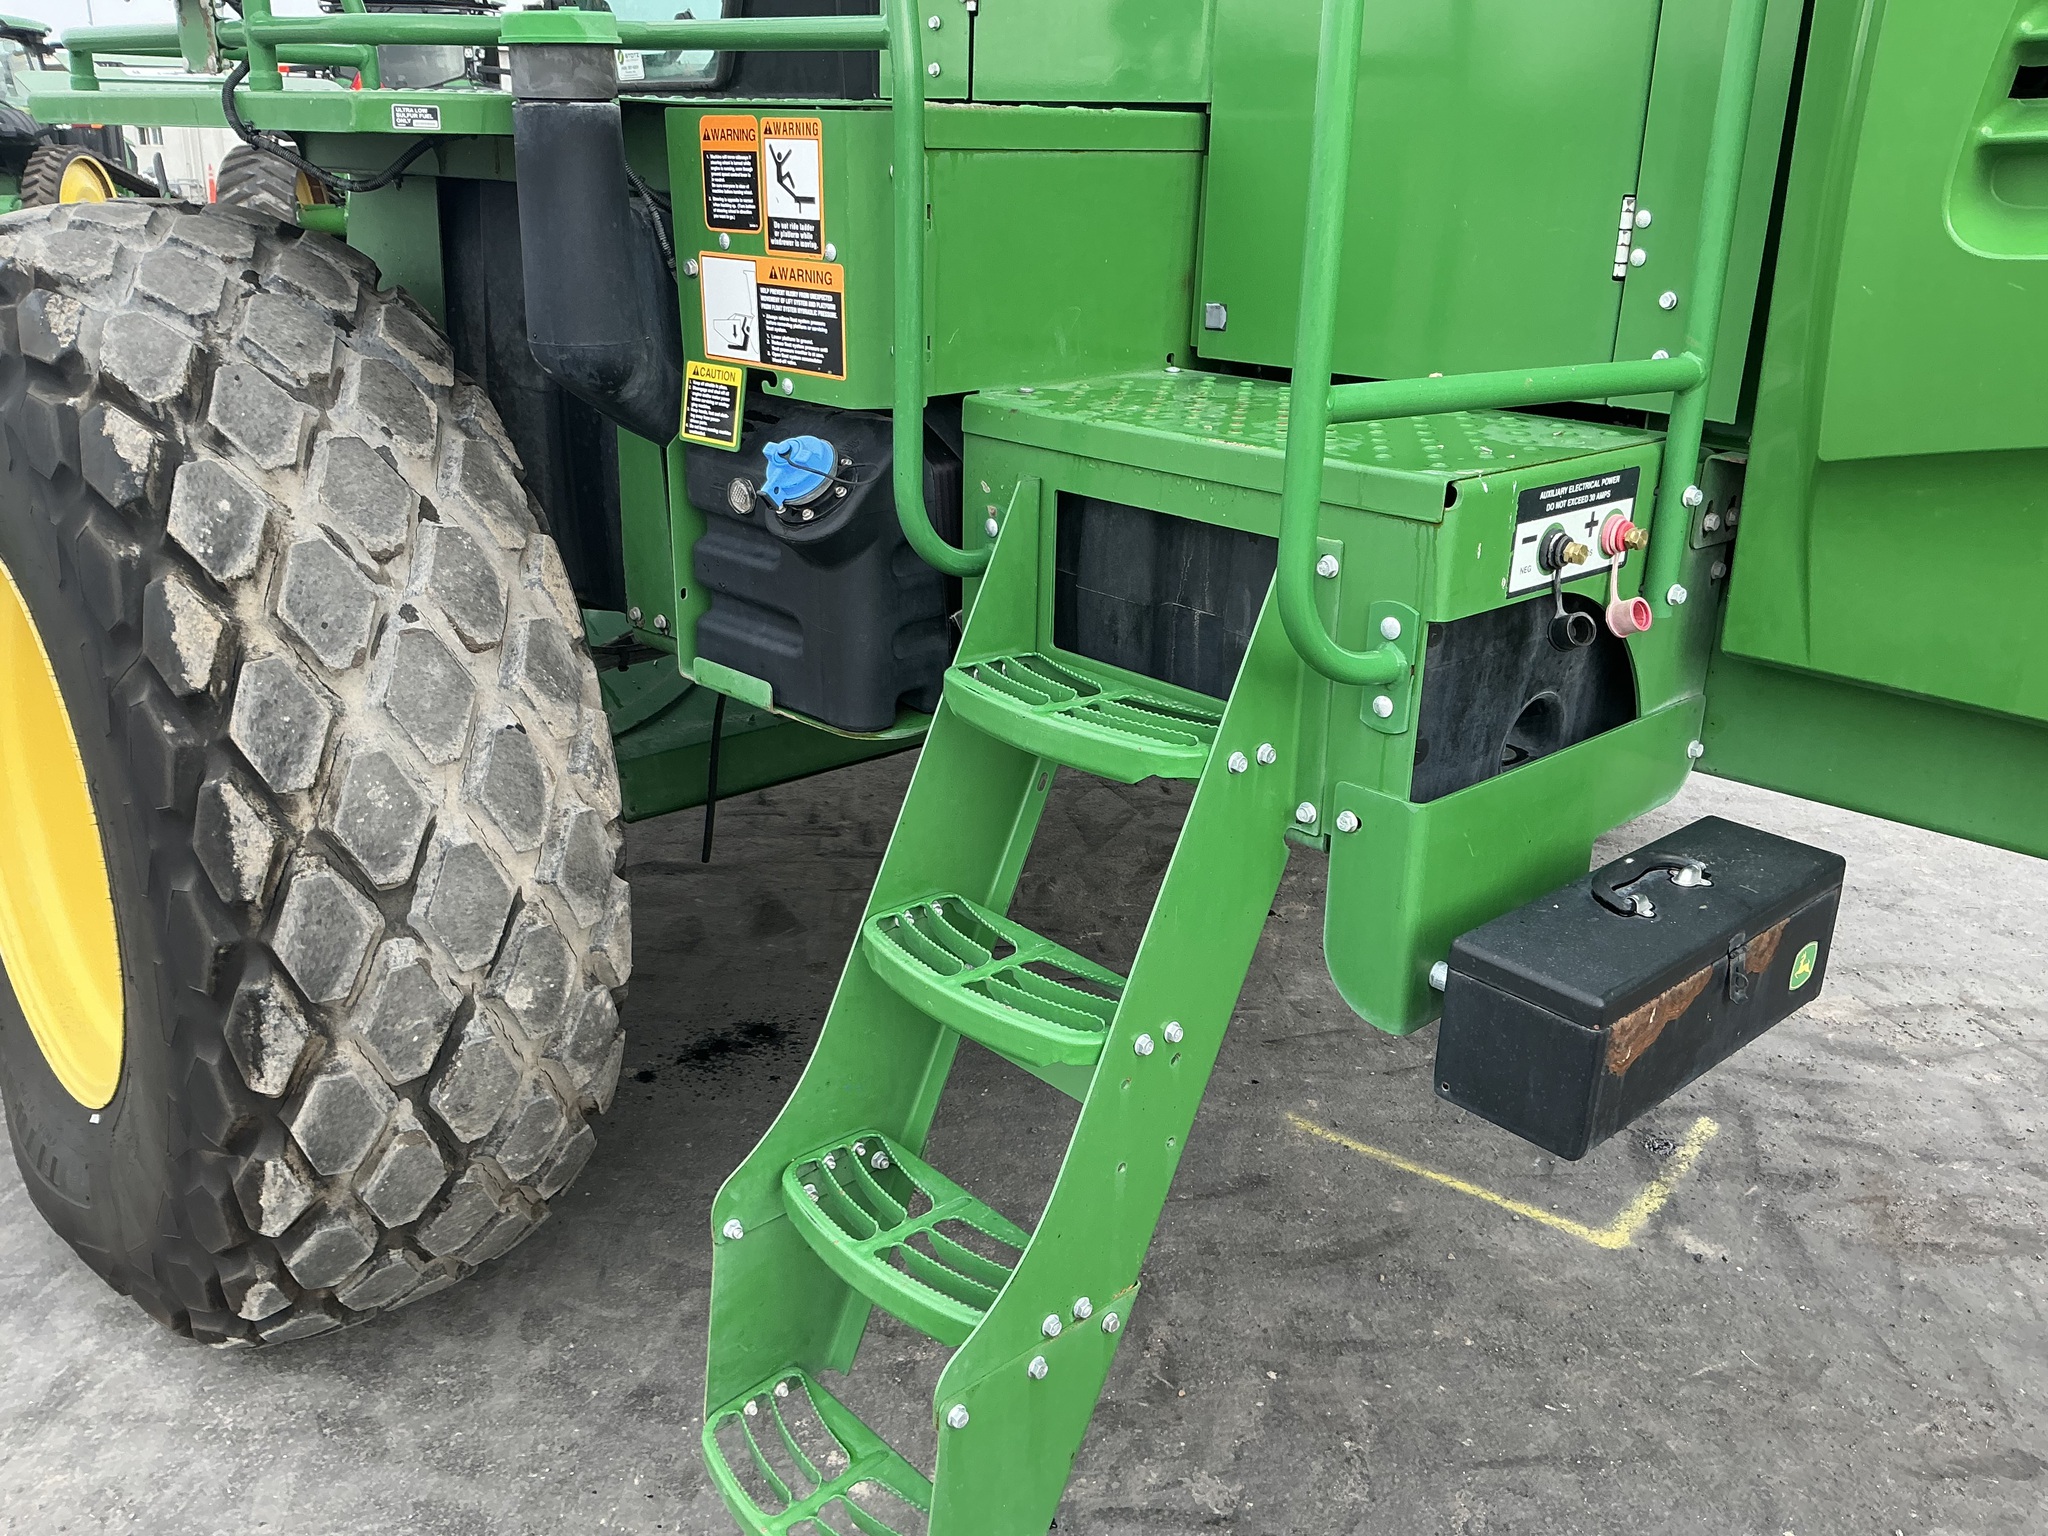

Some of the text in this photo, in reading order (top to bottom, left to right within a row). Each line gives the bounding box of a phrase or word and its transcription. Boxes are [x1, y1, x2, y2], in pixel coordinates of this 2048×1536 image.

[711, 128, 756, 141] WARNING
[773, 122, 819, 136] WARNING
[773, 221, 815, 231] Do not ride ladder
[780, 230, 799, 238] platform
[800, 231, 813, 239] while
[794, 239, 800, 247] is
[778, 266, 833, 285] WARNING
[700, 366, 736, 382] CAUTION
[1540, 475, 1621, 500] AUXILIARY ELECTRICAL POWER
[1546, 490, 1612, 511] DO NOT EXCEED 30 AMPS
[1519, 565, 1532, 574] NEG
